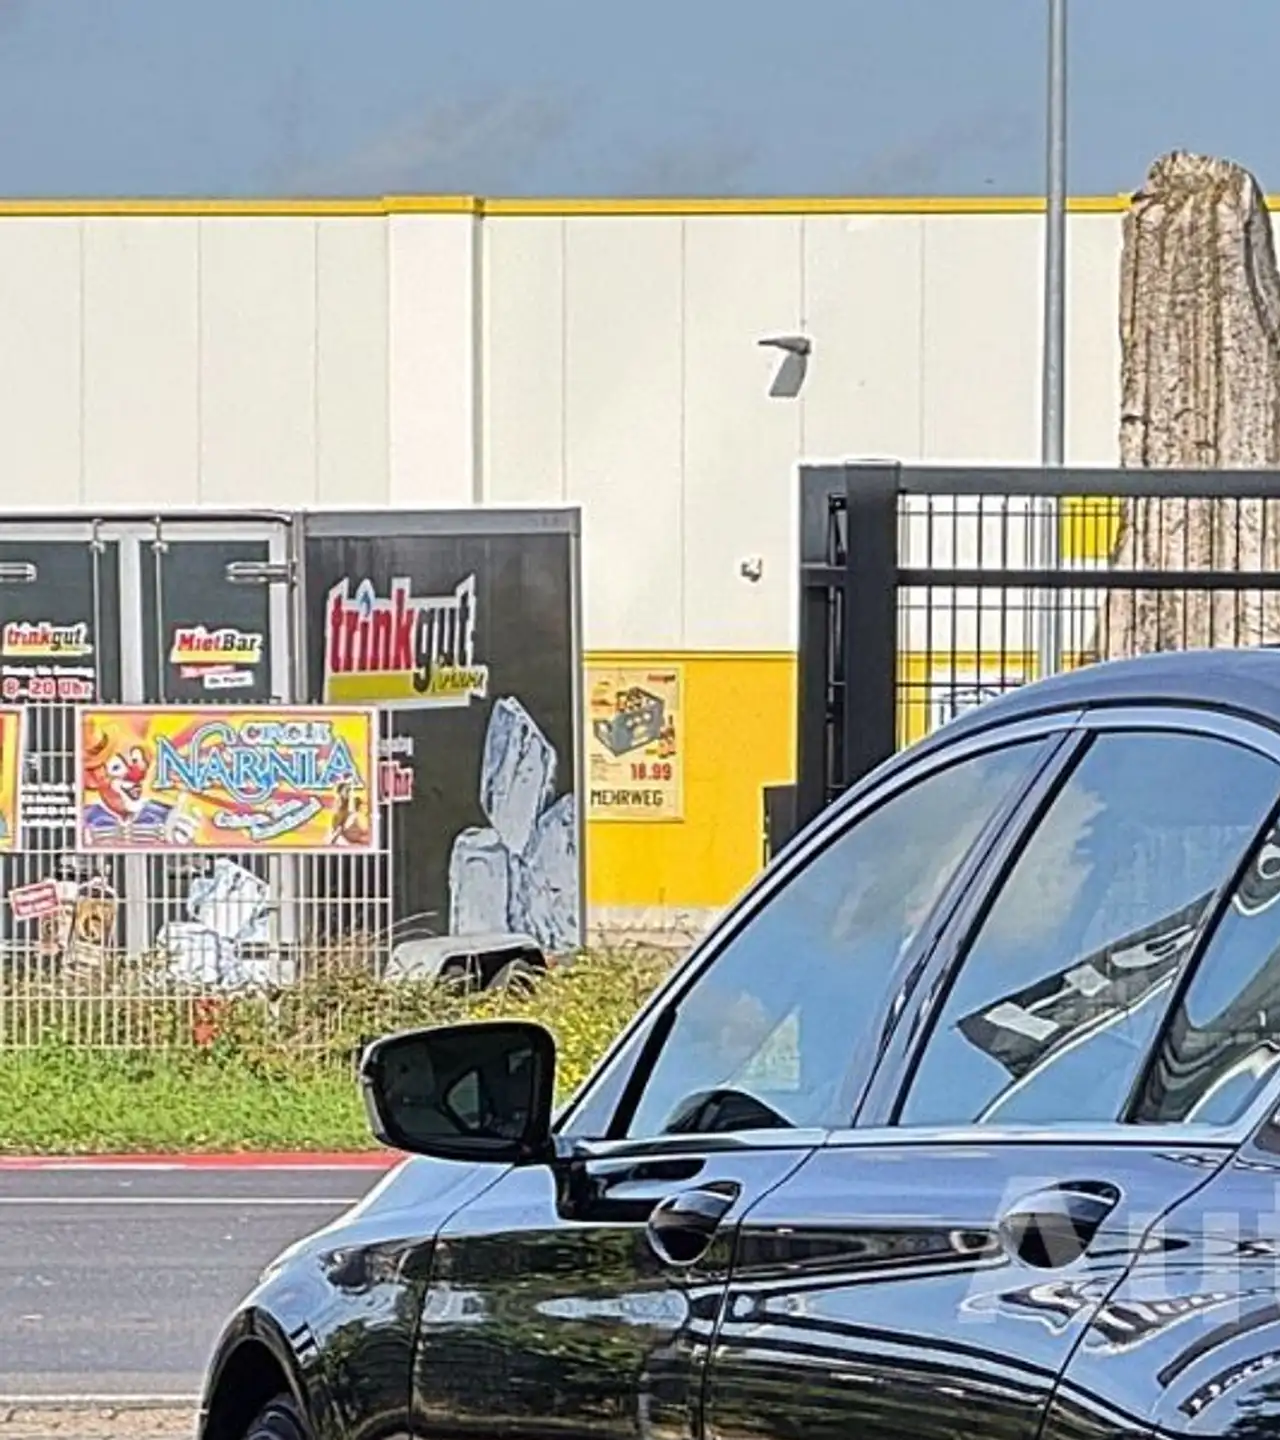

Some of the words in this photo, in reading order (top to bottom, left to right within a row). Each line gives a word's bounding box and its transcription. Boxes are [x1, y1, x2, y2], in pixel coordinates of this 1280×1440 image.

[6, 625, 83, 652] trinkgut
[177, 632, 259, 653] MietBar
[331, 587, 472, 693] trinkgut
[152, 722, 367, 803] NARNIA
[590, 788, 665, 807] MEHRWEG
